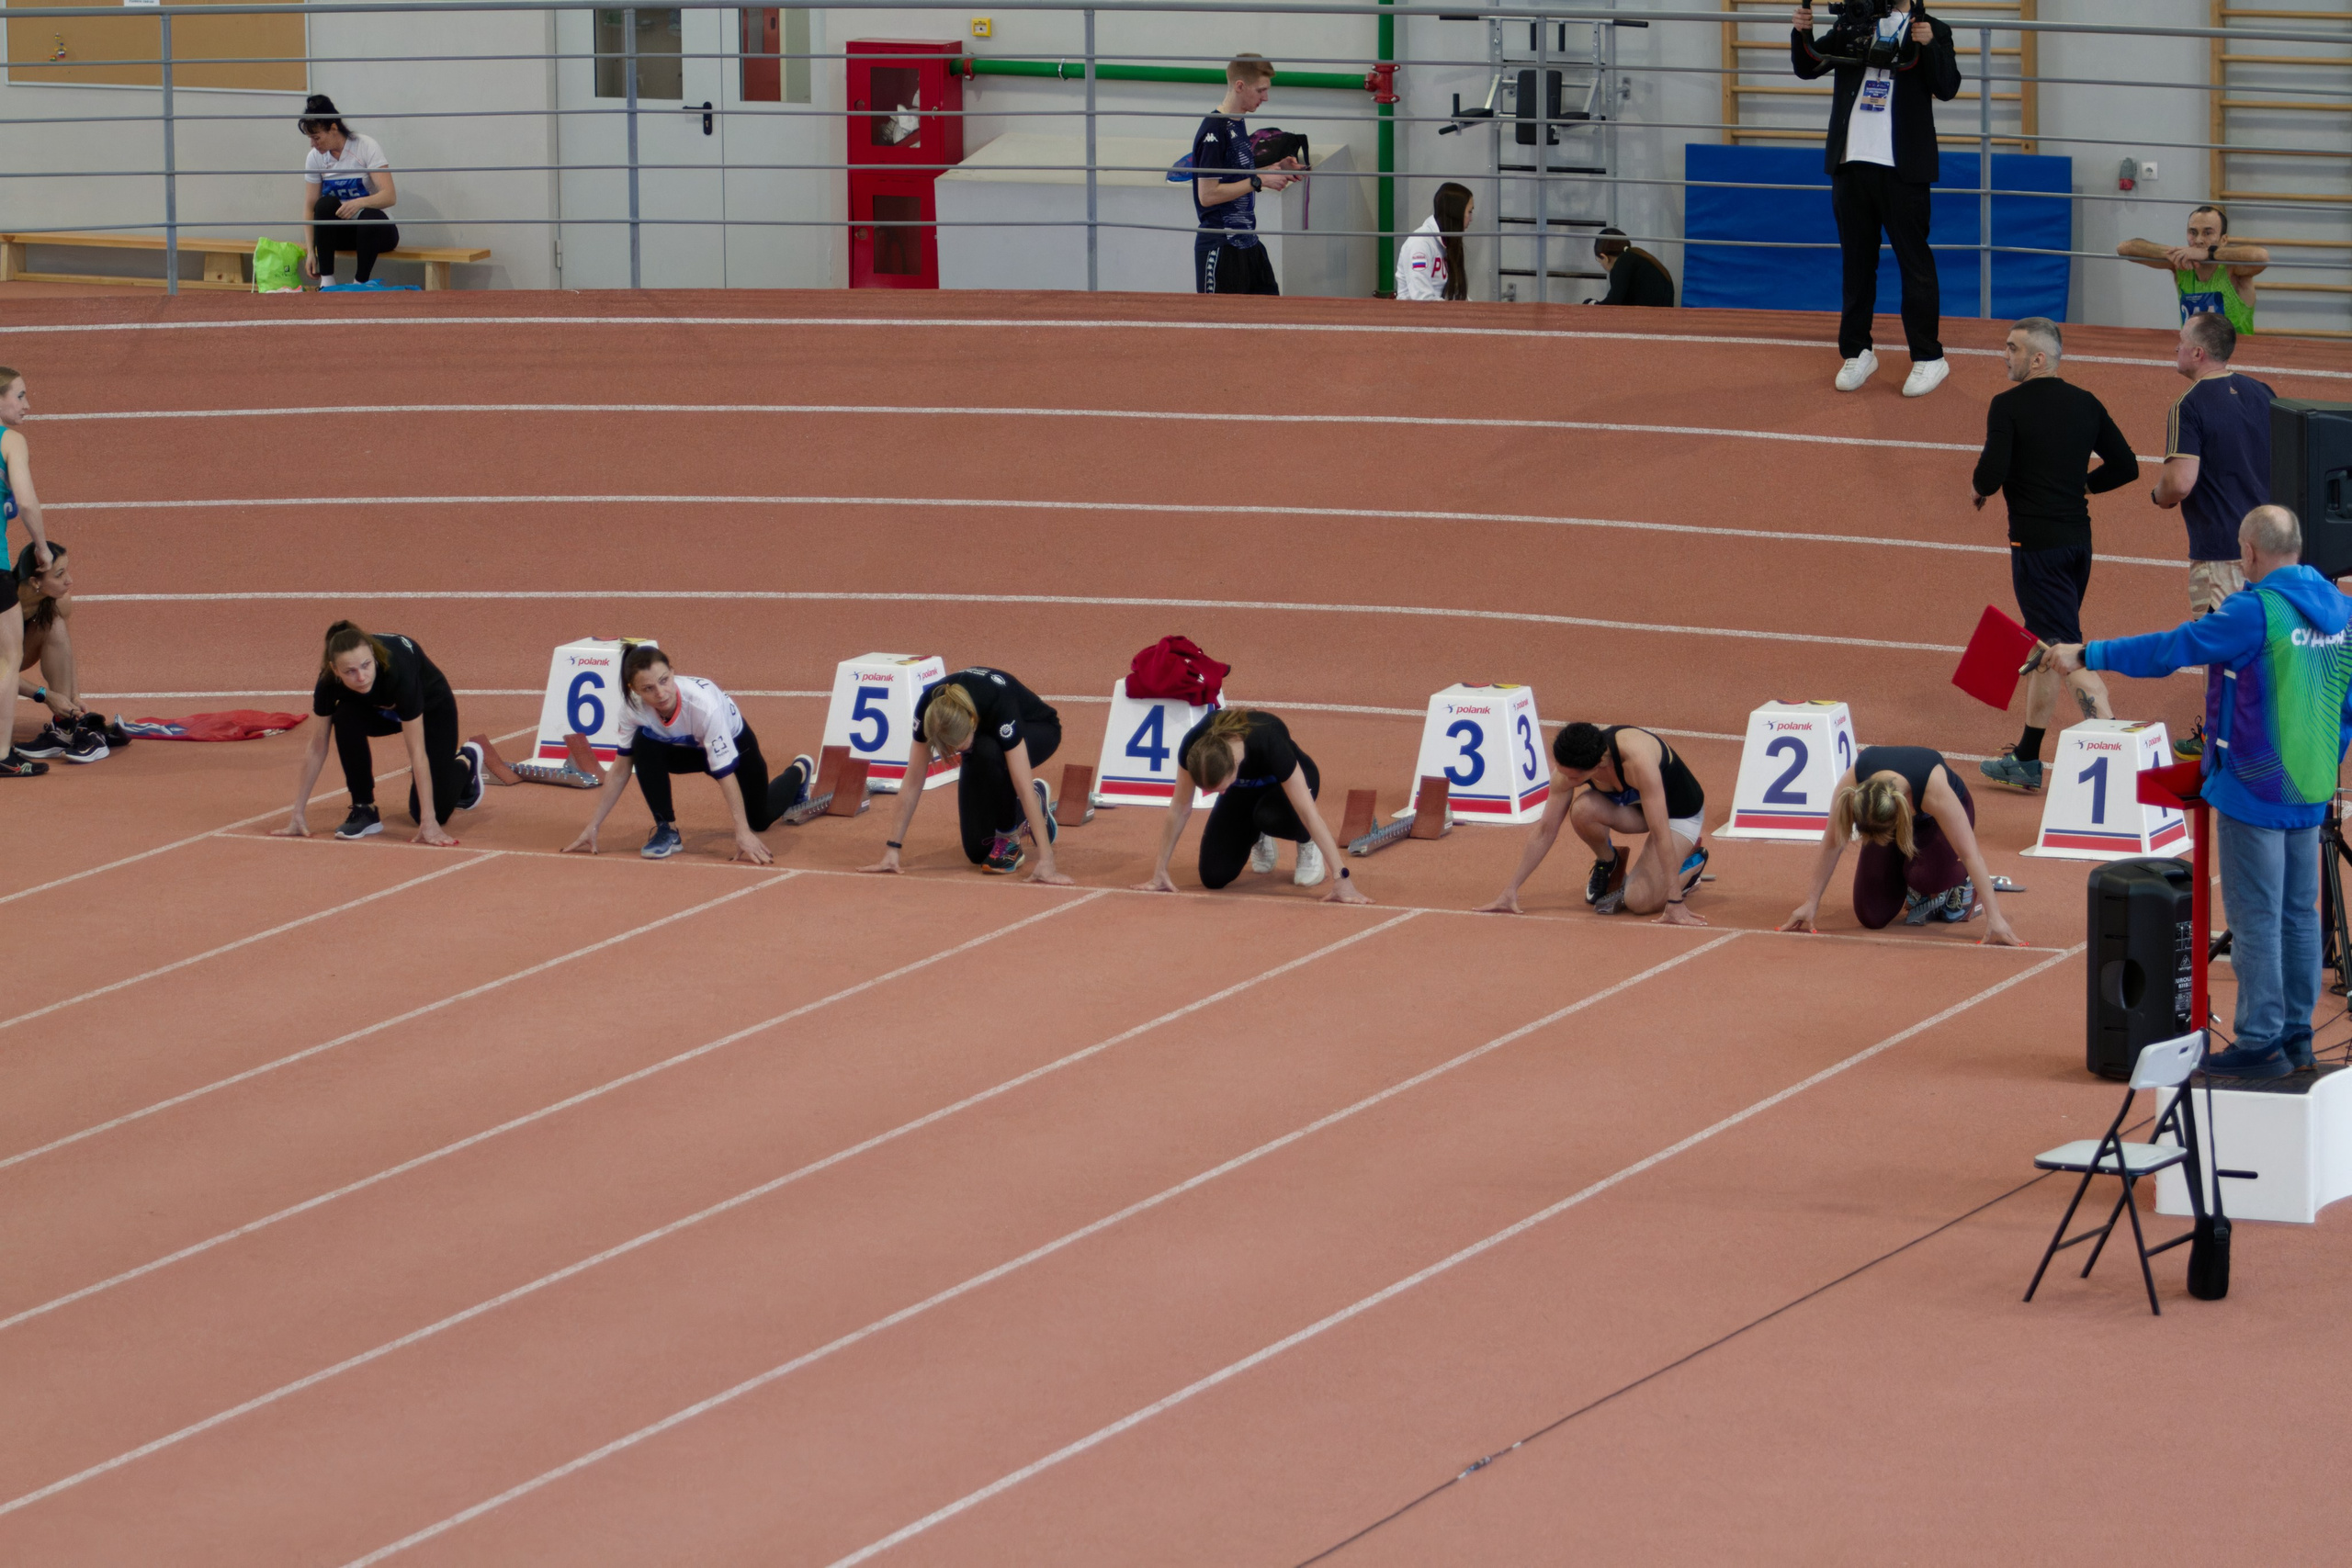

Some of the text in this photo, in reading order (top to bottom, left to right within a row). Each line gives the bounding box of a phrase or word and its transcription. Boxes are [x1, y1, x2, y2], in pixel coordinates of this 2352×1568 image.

[567, 671, 605, 737] 6
[849, 686, 889, 752] 5
[1125, 705, 1170, 772] 4
[1443, 719, 1485, 786] 3
[1517, 714, 1537, 782] 3
[1762, 736, 1808, 805] 2
[2078, 757, 2109, 824] 1
